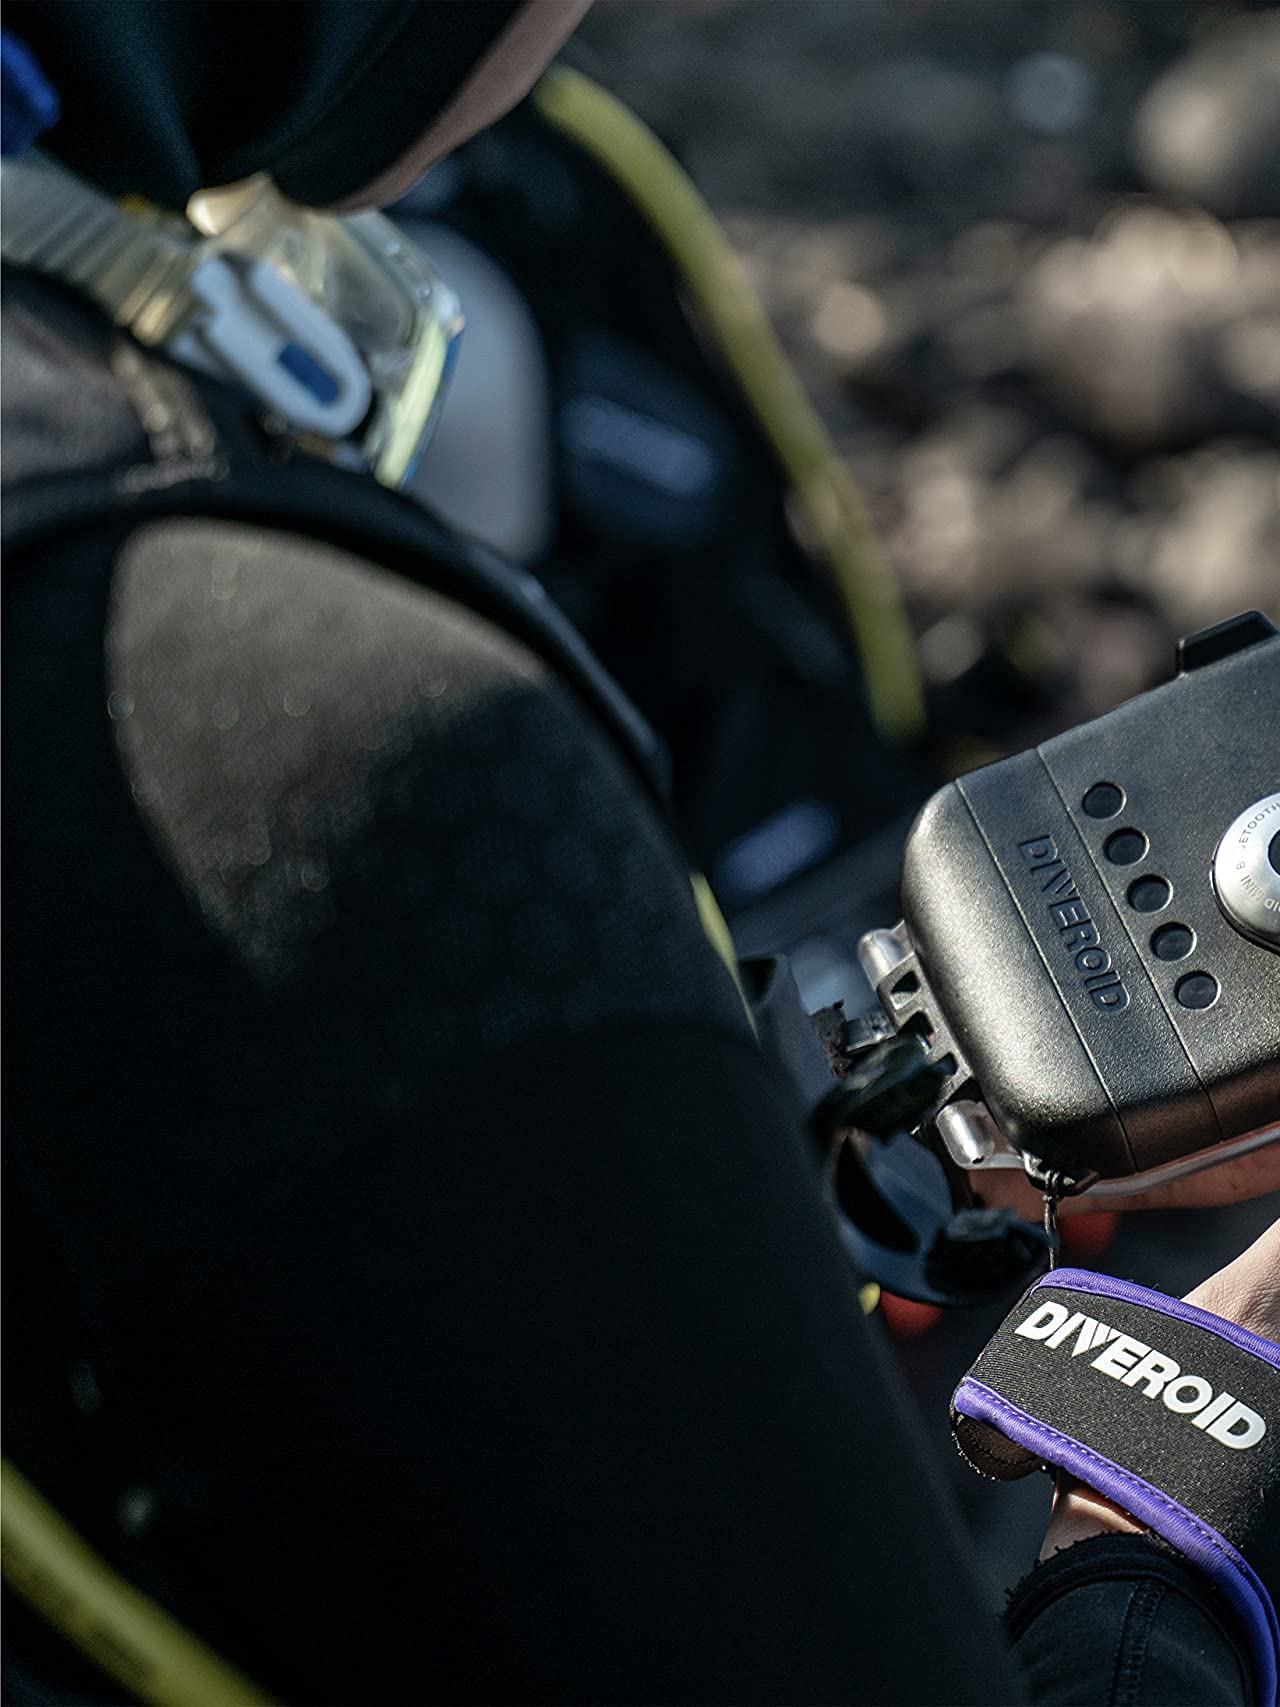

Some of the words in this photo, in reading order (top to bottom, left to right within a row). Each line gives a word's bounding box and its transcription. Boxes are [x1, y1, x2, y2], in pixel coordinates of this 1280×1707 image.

[1018, 834, 1130, 1012] DIVEROID
[1241, 874, 1265, 902] MINI
[1015, 1301, 1266, 1450] DIVEROID
